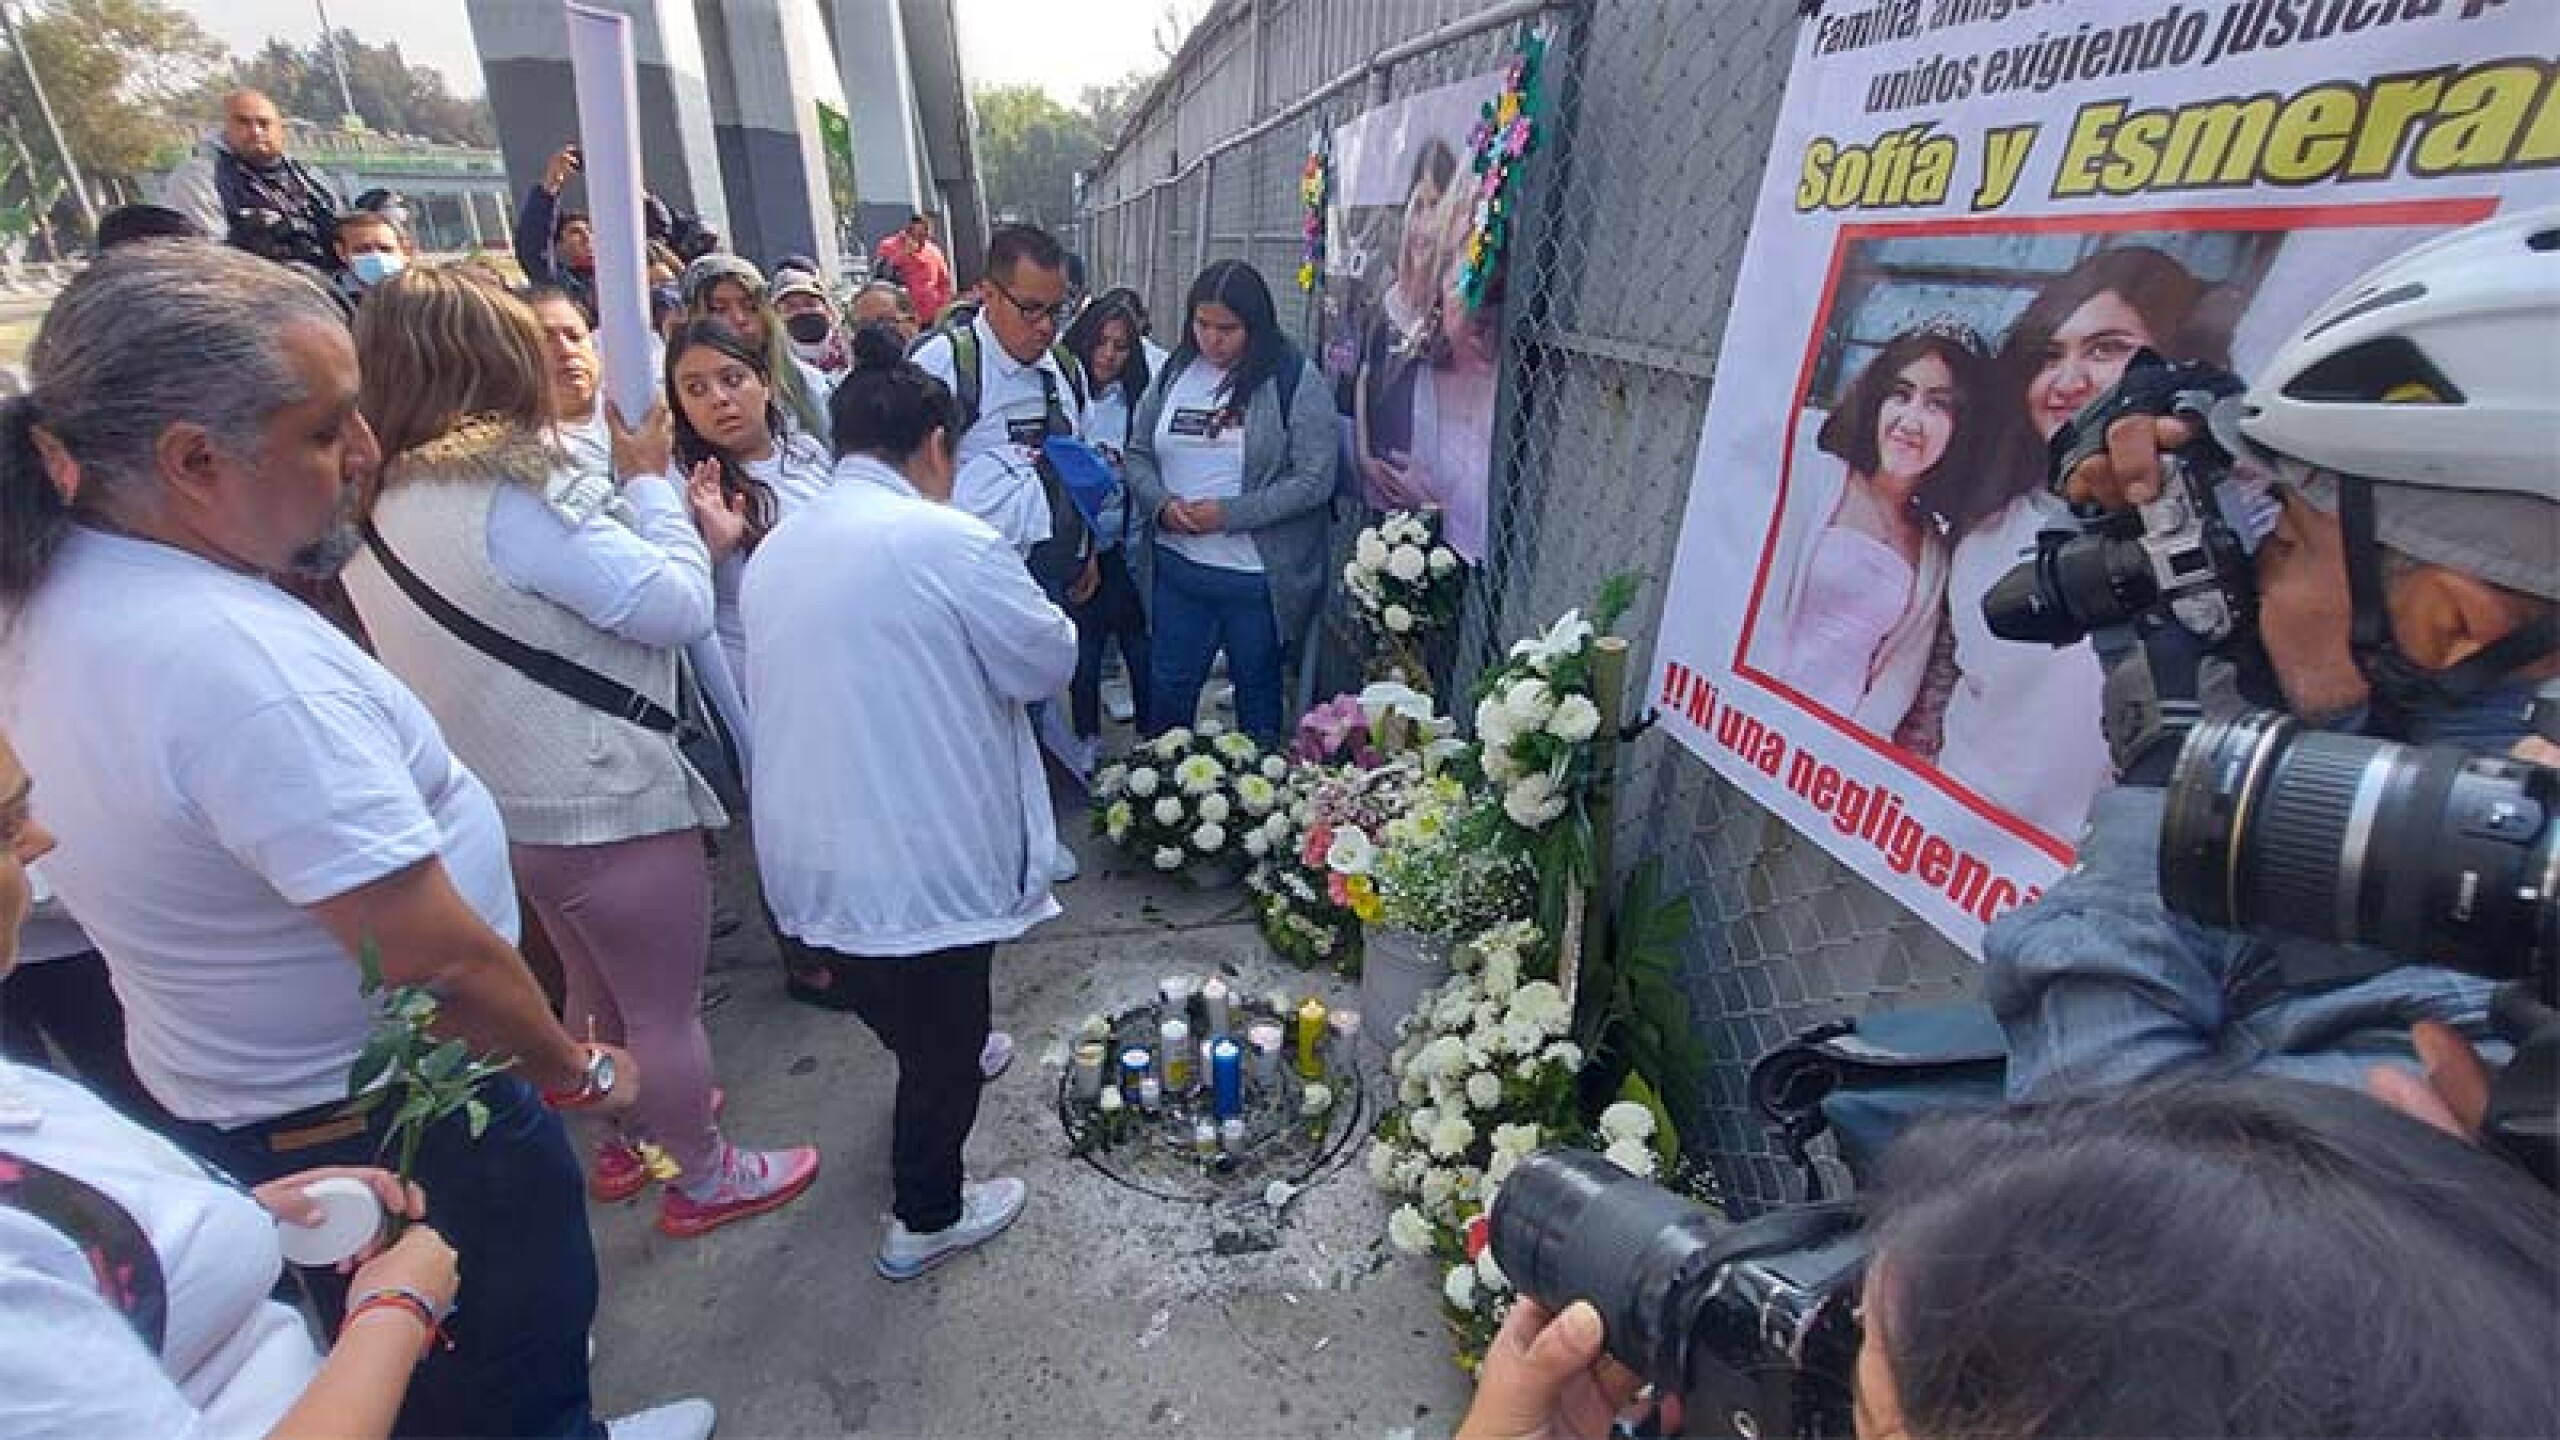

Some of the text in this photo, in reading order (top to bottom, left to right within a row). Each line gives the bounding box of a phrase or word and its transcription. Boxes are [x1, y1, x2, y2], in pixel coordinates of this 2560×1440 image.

[1865, 53, 1978, 114] unidos
[1980, 4, 2208, 93] exigiendo
[1795, 119, 1958, 211] Sofía
[1971, 121, 2043, 211] y
[1686, 675, 1719, 731] Ni
[1717, 703, 1786, 778] una
[1788, 747, 2042, 925] negligenc
